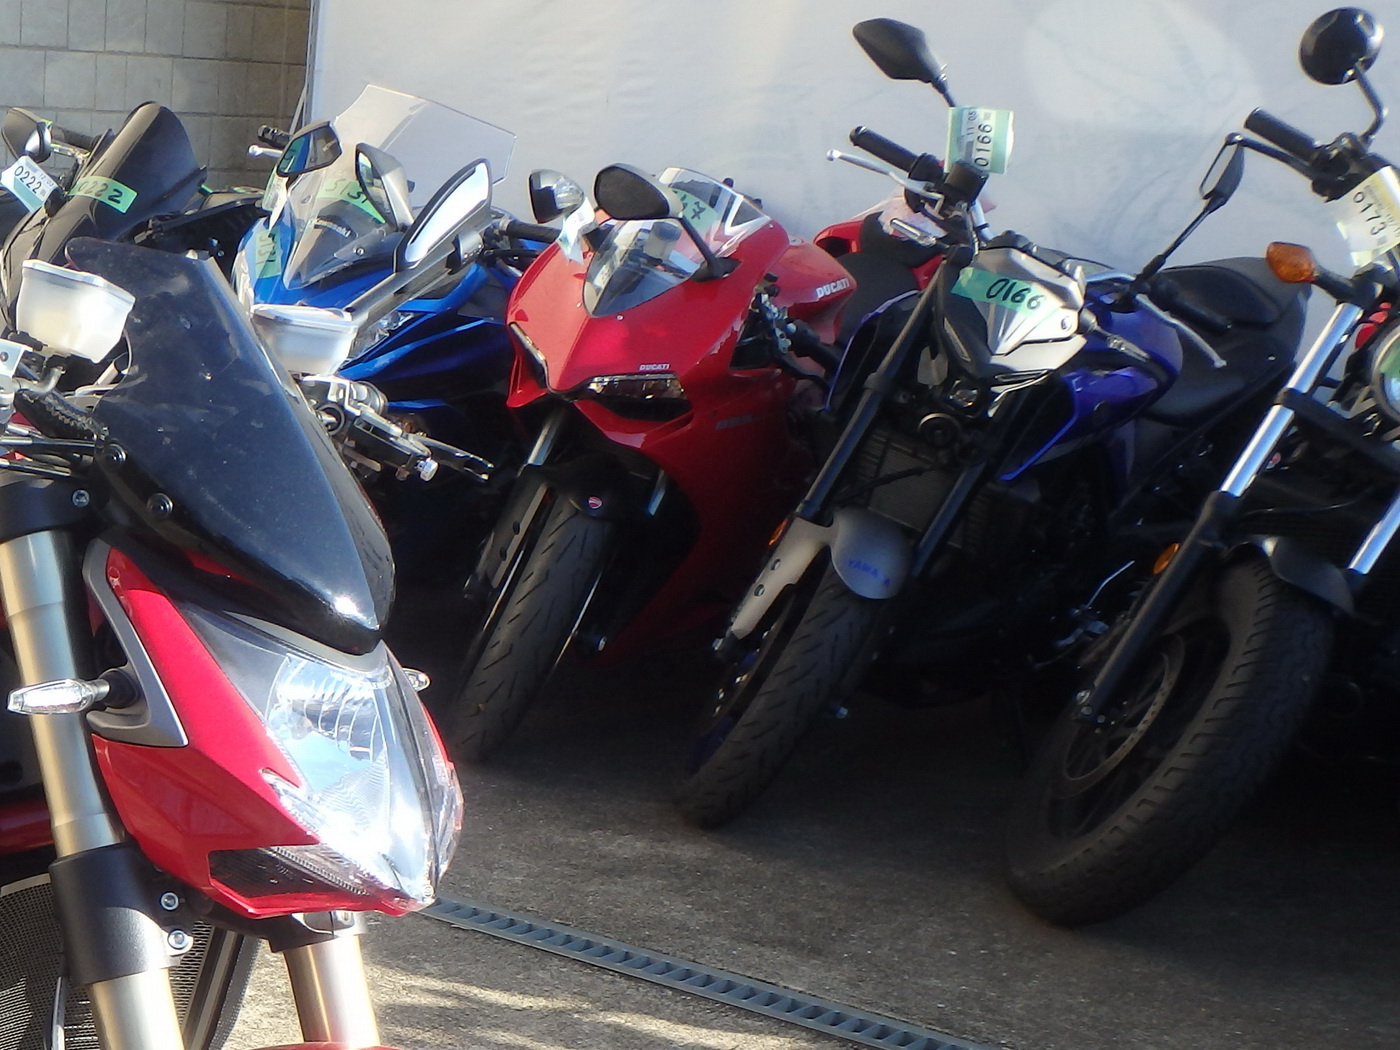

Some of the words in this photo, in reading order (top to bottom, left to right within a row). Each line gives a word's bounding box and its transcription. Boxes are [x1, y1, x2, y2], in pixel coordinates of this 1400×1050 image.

[974, 123, 993, 167] 0166
[13, 165, 42, 195] 0222
[77, 180, 123, 205] 0222
[1352, 191, 1388, 236] 0173
[815, 277, 850, 299] DUCATI
[985, 278, 1046, 310] 0166
[639, 363, 670, 372] DUCATI
[847, 559, 891, 589] YAMAA
